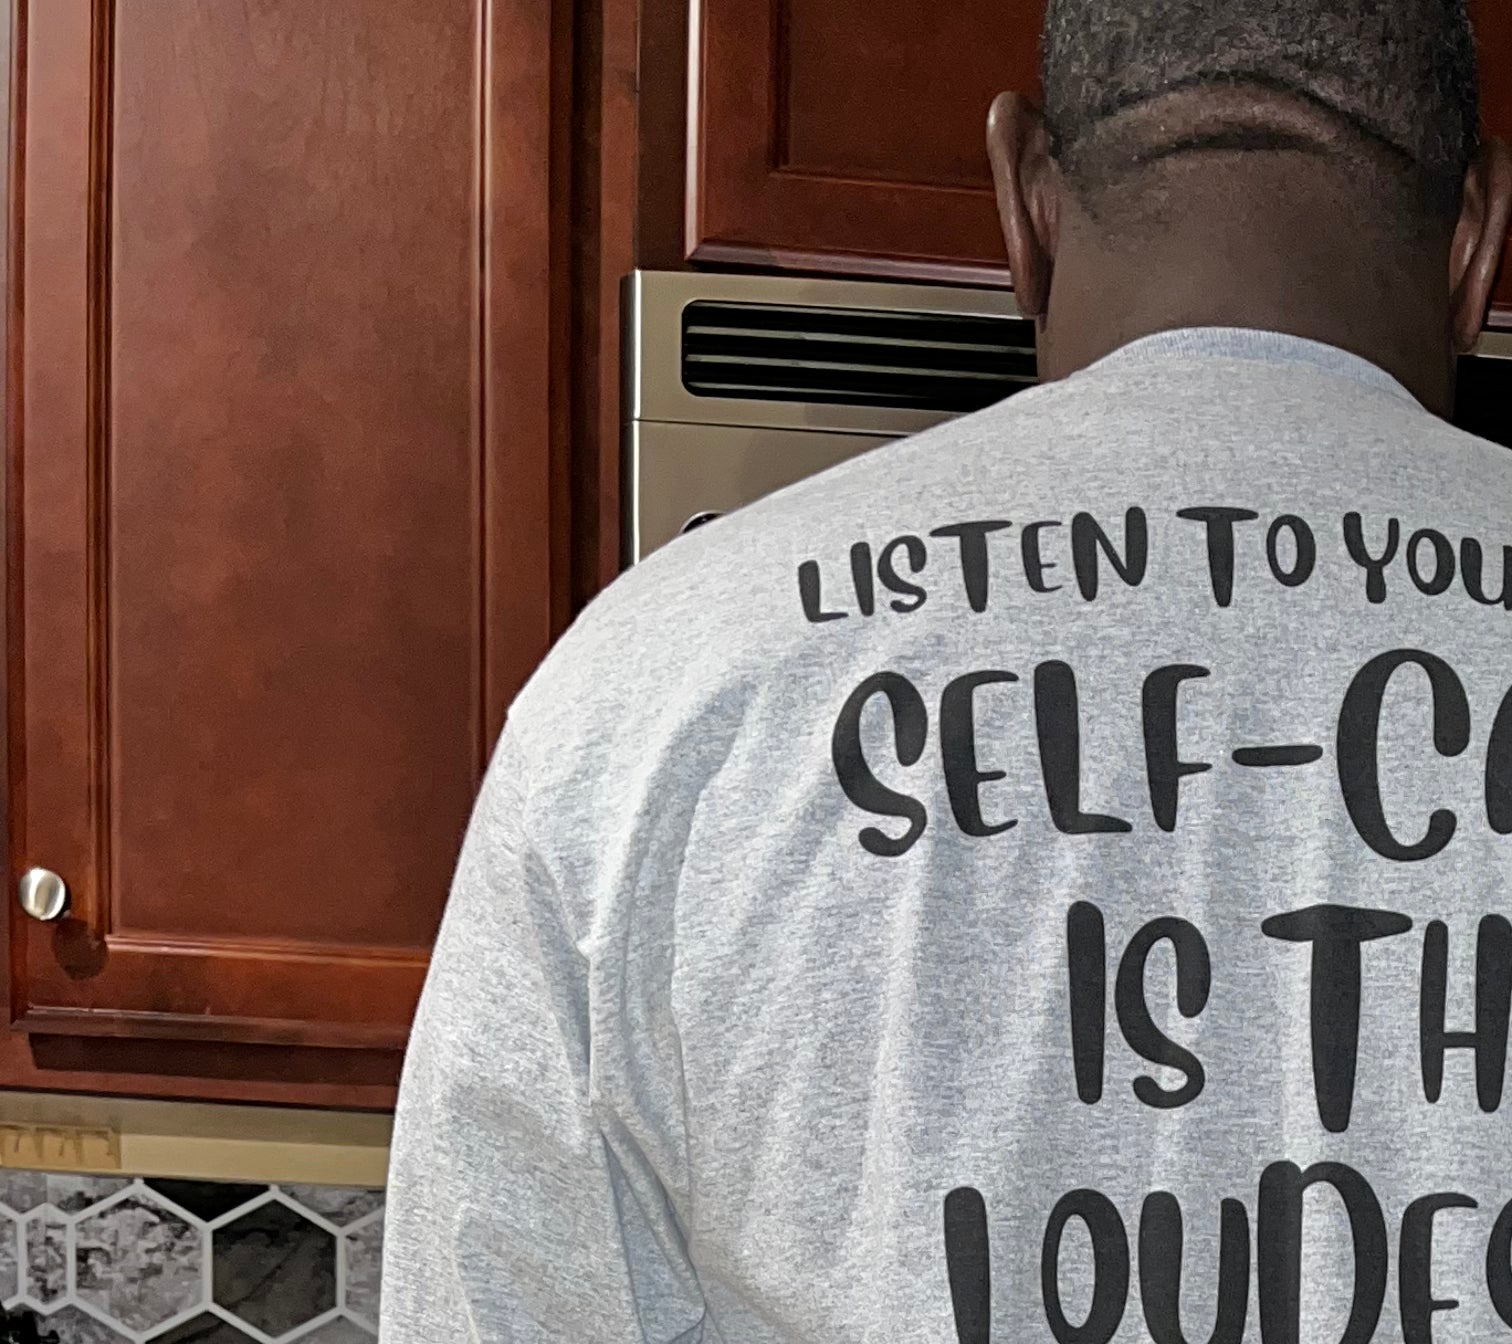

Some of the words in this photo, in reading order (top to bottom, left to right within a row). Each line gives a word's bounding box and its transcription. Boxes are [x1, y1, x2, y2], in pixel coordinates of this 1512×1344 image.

[799, 507, 1147, 622] LISTEN
[1177, 507, 1316, 607] TO
[1067, 901, 1211, 1108] IS
